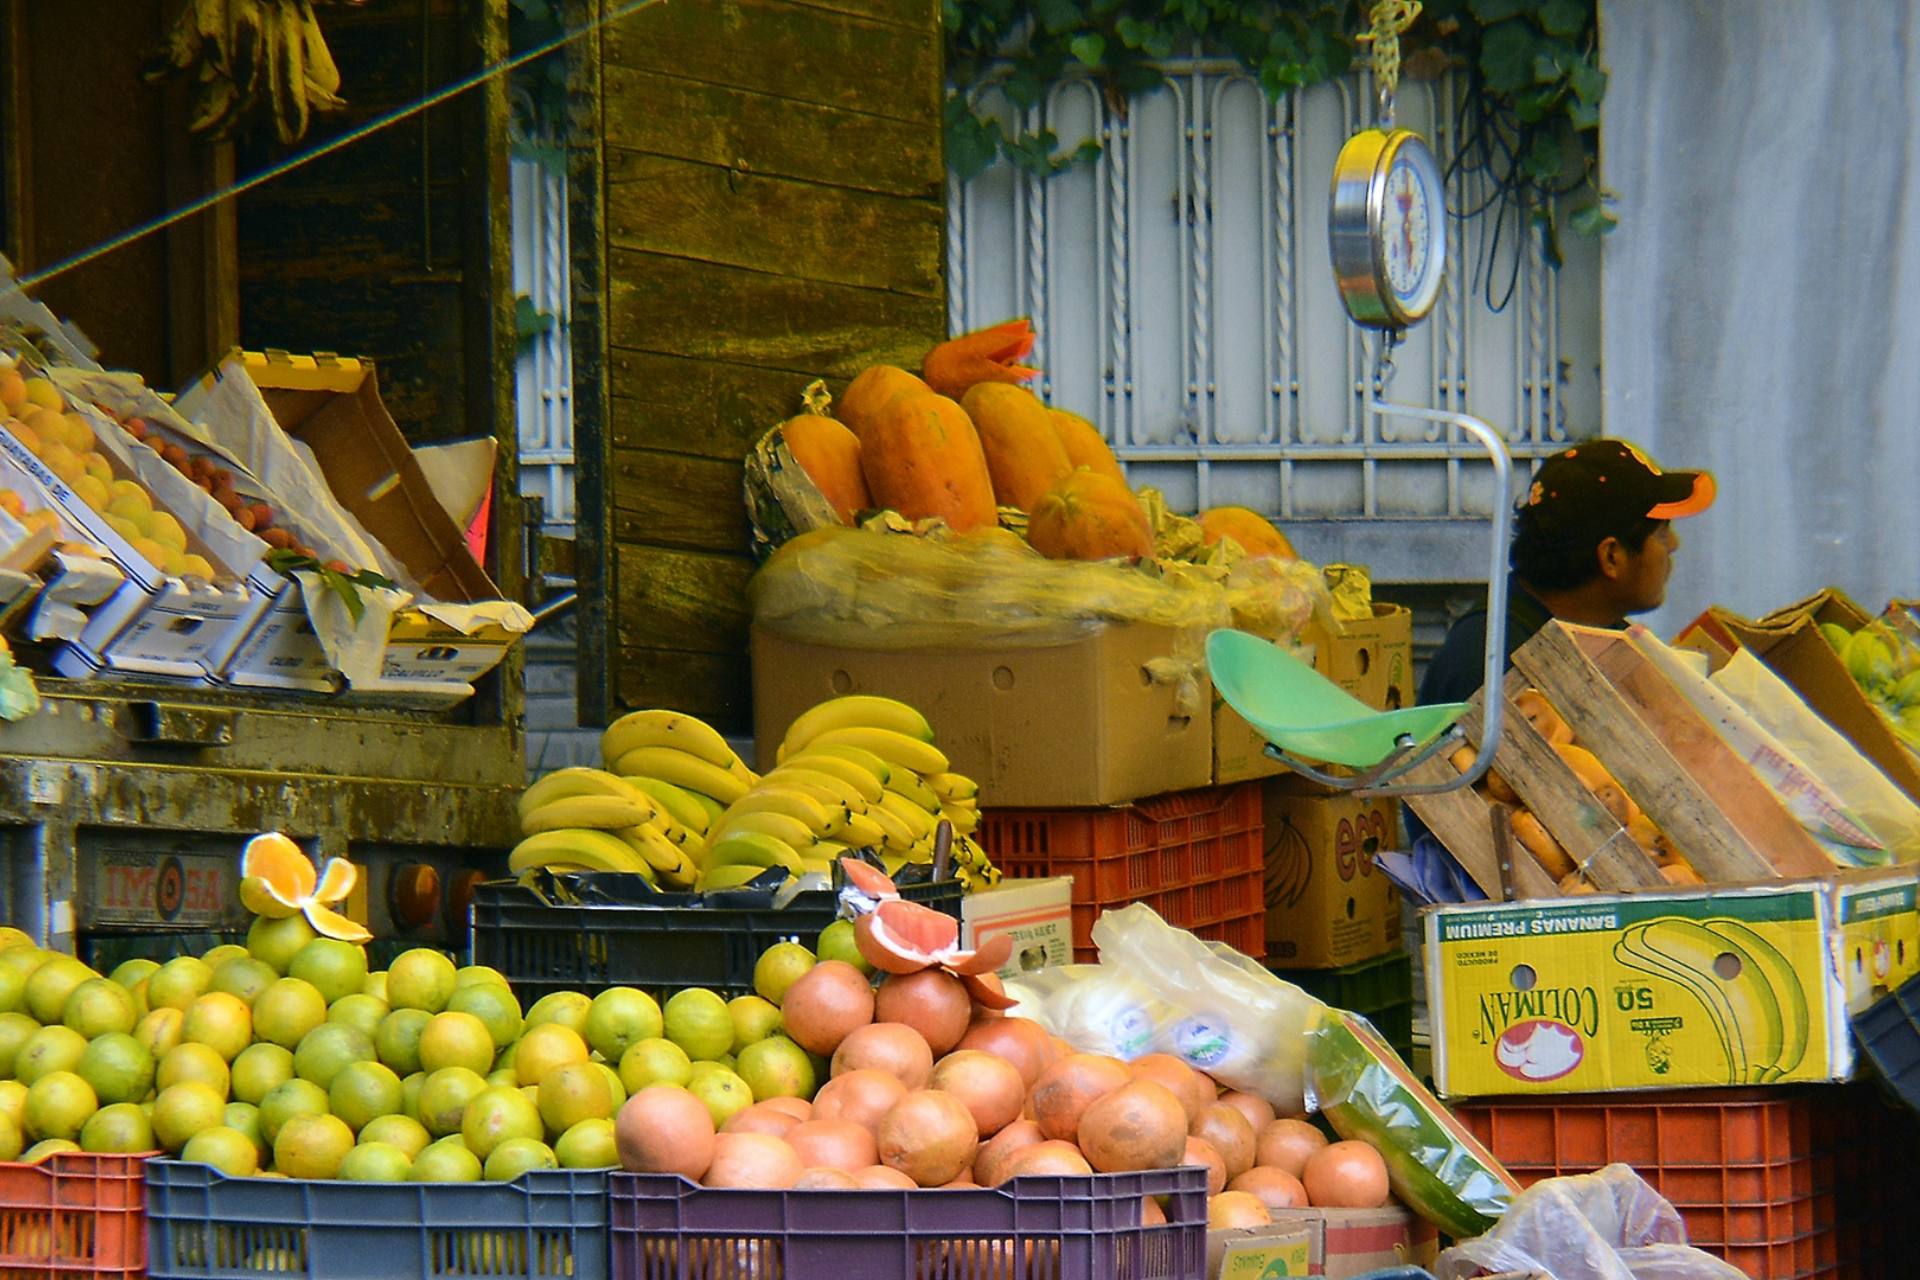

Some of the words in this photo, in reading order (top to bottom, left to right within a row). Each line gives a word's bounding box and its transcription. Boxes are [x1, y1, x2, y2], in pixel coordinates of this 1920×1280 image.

[52, 483, 70, 502] DE
[106, 860, 223, 916] IMOSA
[1446, 921, 1525, 939] PREMIUM
[1531, 914, 1616, 933] BANANAS
[1457, 958, 1499, 967] PRODUCTO
[1617, 988, 1654, 1011] 50
[1480, 986, 1599, 1045] COLIMAN
